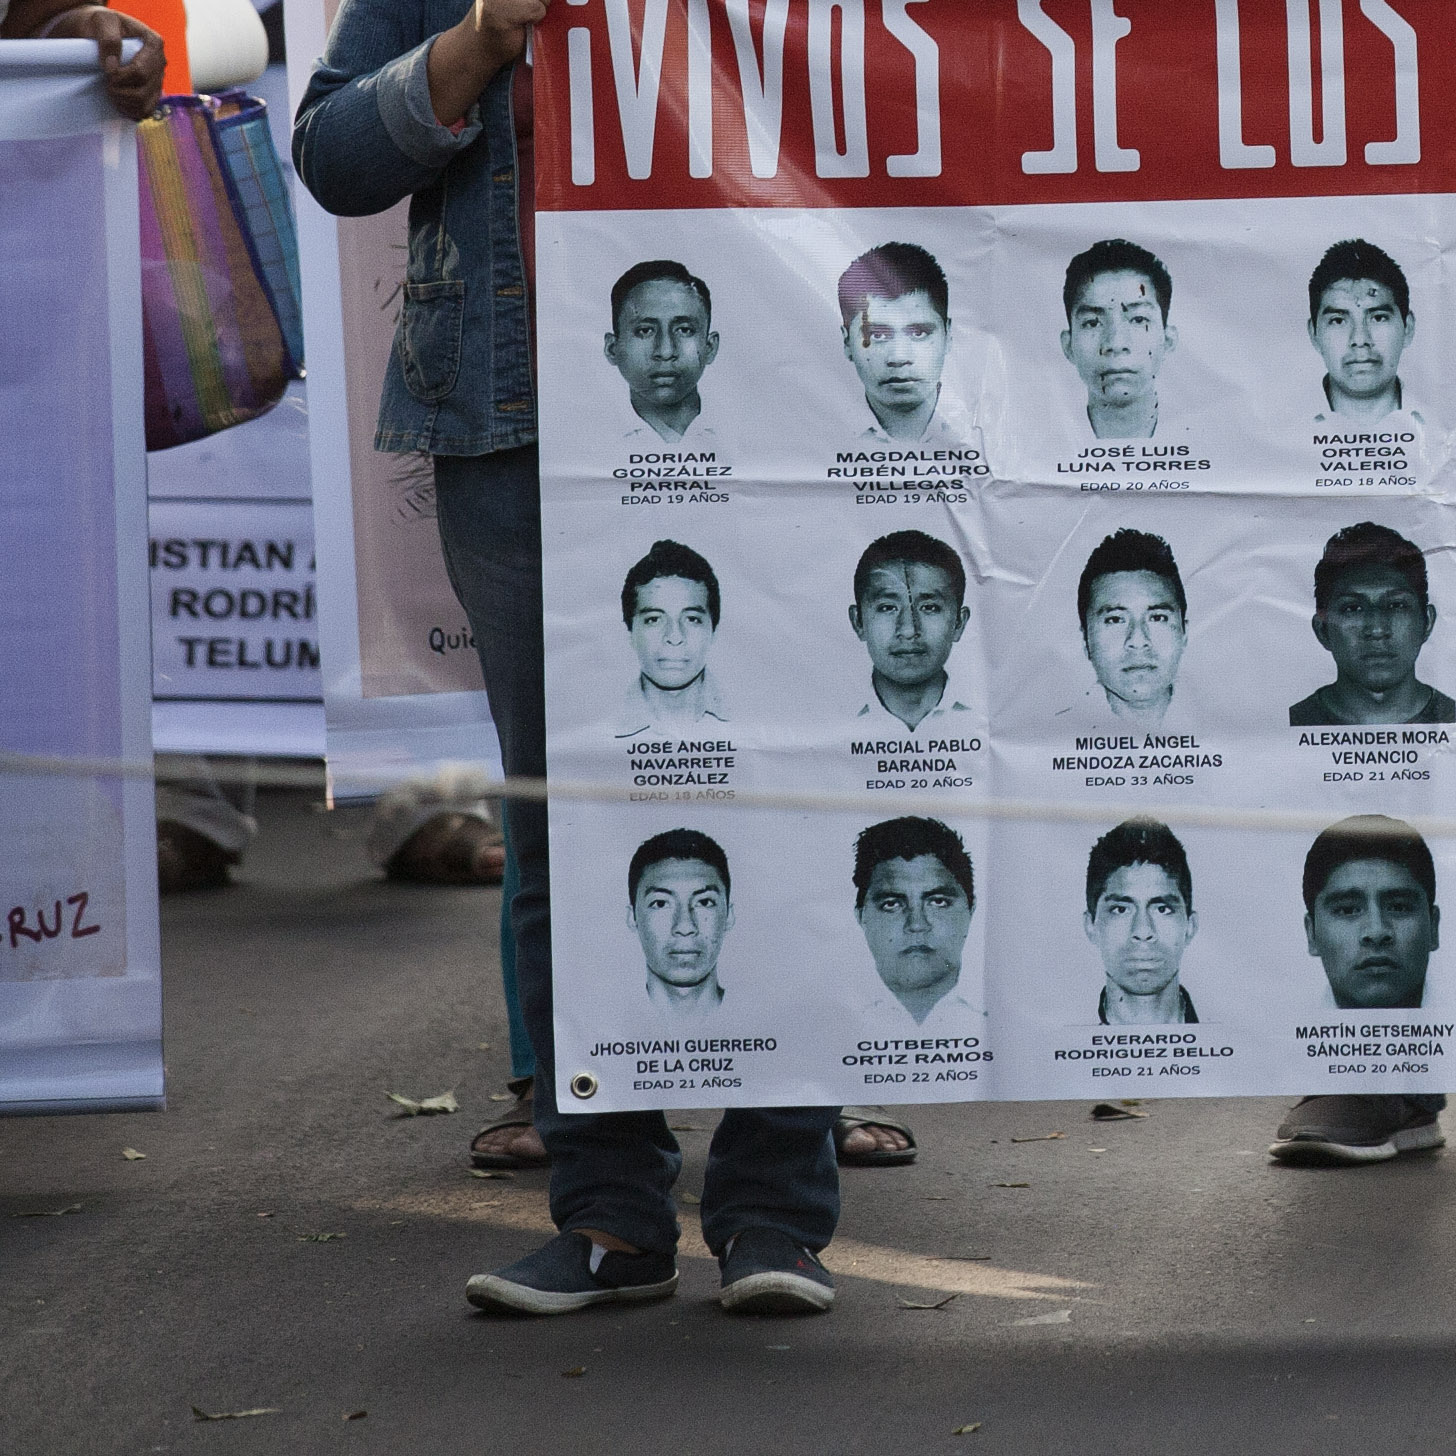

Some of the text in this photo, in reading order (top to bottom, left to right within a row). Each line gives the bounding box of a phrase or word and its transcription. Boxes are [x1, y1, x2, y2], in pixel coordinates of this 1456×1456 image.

[629, 453, 716, 464] DORIAM
[1077, 444, 1190, 458] JOSÉ LUIS
[612, 464, 732, 478] GONZÁLEZ
[1057, 460, 1211, 473] LUNA TORRES
[630, 480, 717, 492] PARRAL
[169, 582, 315, 620] RODRÍ
[1075, 731, 1200, 751] MIGUEL ÁNGEL
[1298, 730, 1450, 747] ALEXANDER MORA
[850, 738, 982, 755] MARCIAL PABLO
[1052, 756, 1135, 770] MENDOZA
[1331, 750, 1419, 765] VENANCIO
[877, 758, 957, 773] BARANDA
[1085, 771, 1194, 787] EDAD 33 AÑOS
[1323, 766, 1431, 782] EDAD 21 AÑOS
[0, 891, 101, 949] RUZ
[1295, 1022, 1455, 1038] MARTÍN GETSEMANY
[589, 1038, 778, 1056] JHOSIVANI GUERRERO
[1091, 1034, 1197, 1046] EVERARDO
[1306, 1038, 1444, 1057] SÁNCHEZ GARCÍA
[1173, 1046, 1234, 1057] BELLO
[636, 1058, 734, 1073] DE LA CRUZ
[1328, 1060, 1429, 1074] EDAD 20 AÑOS
